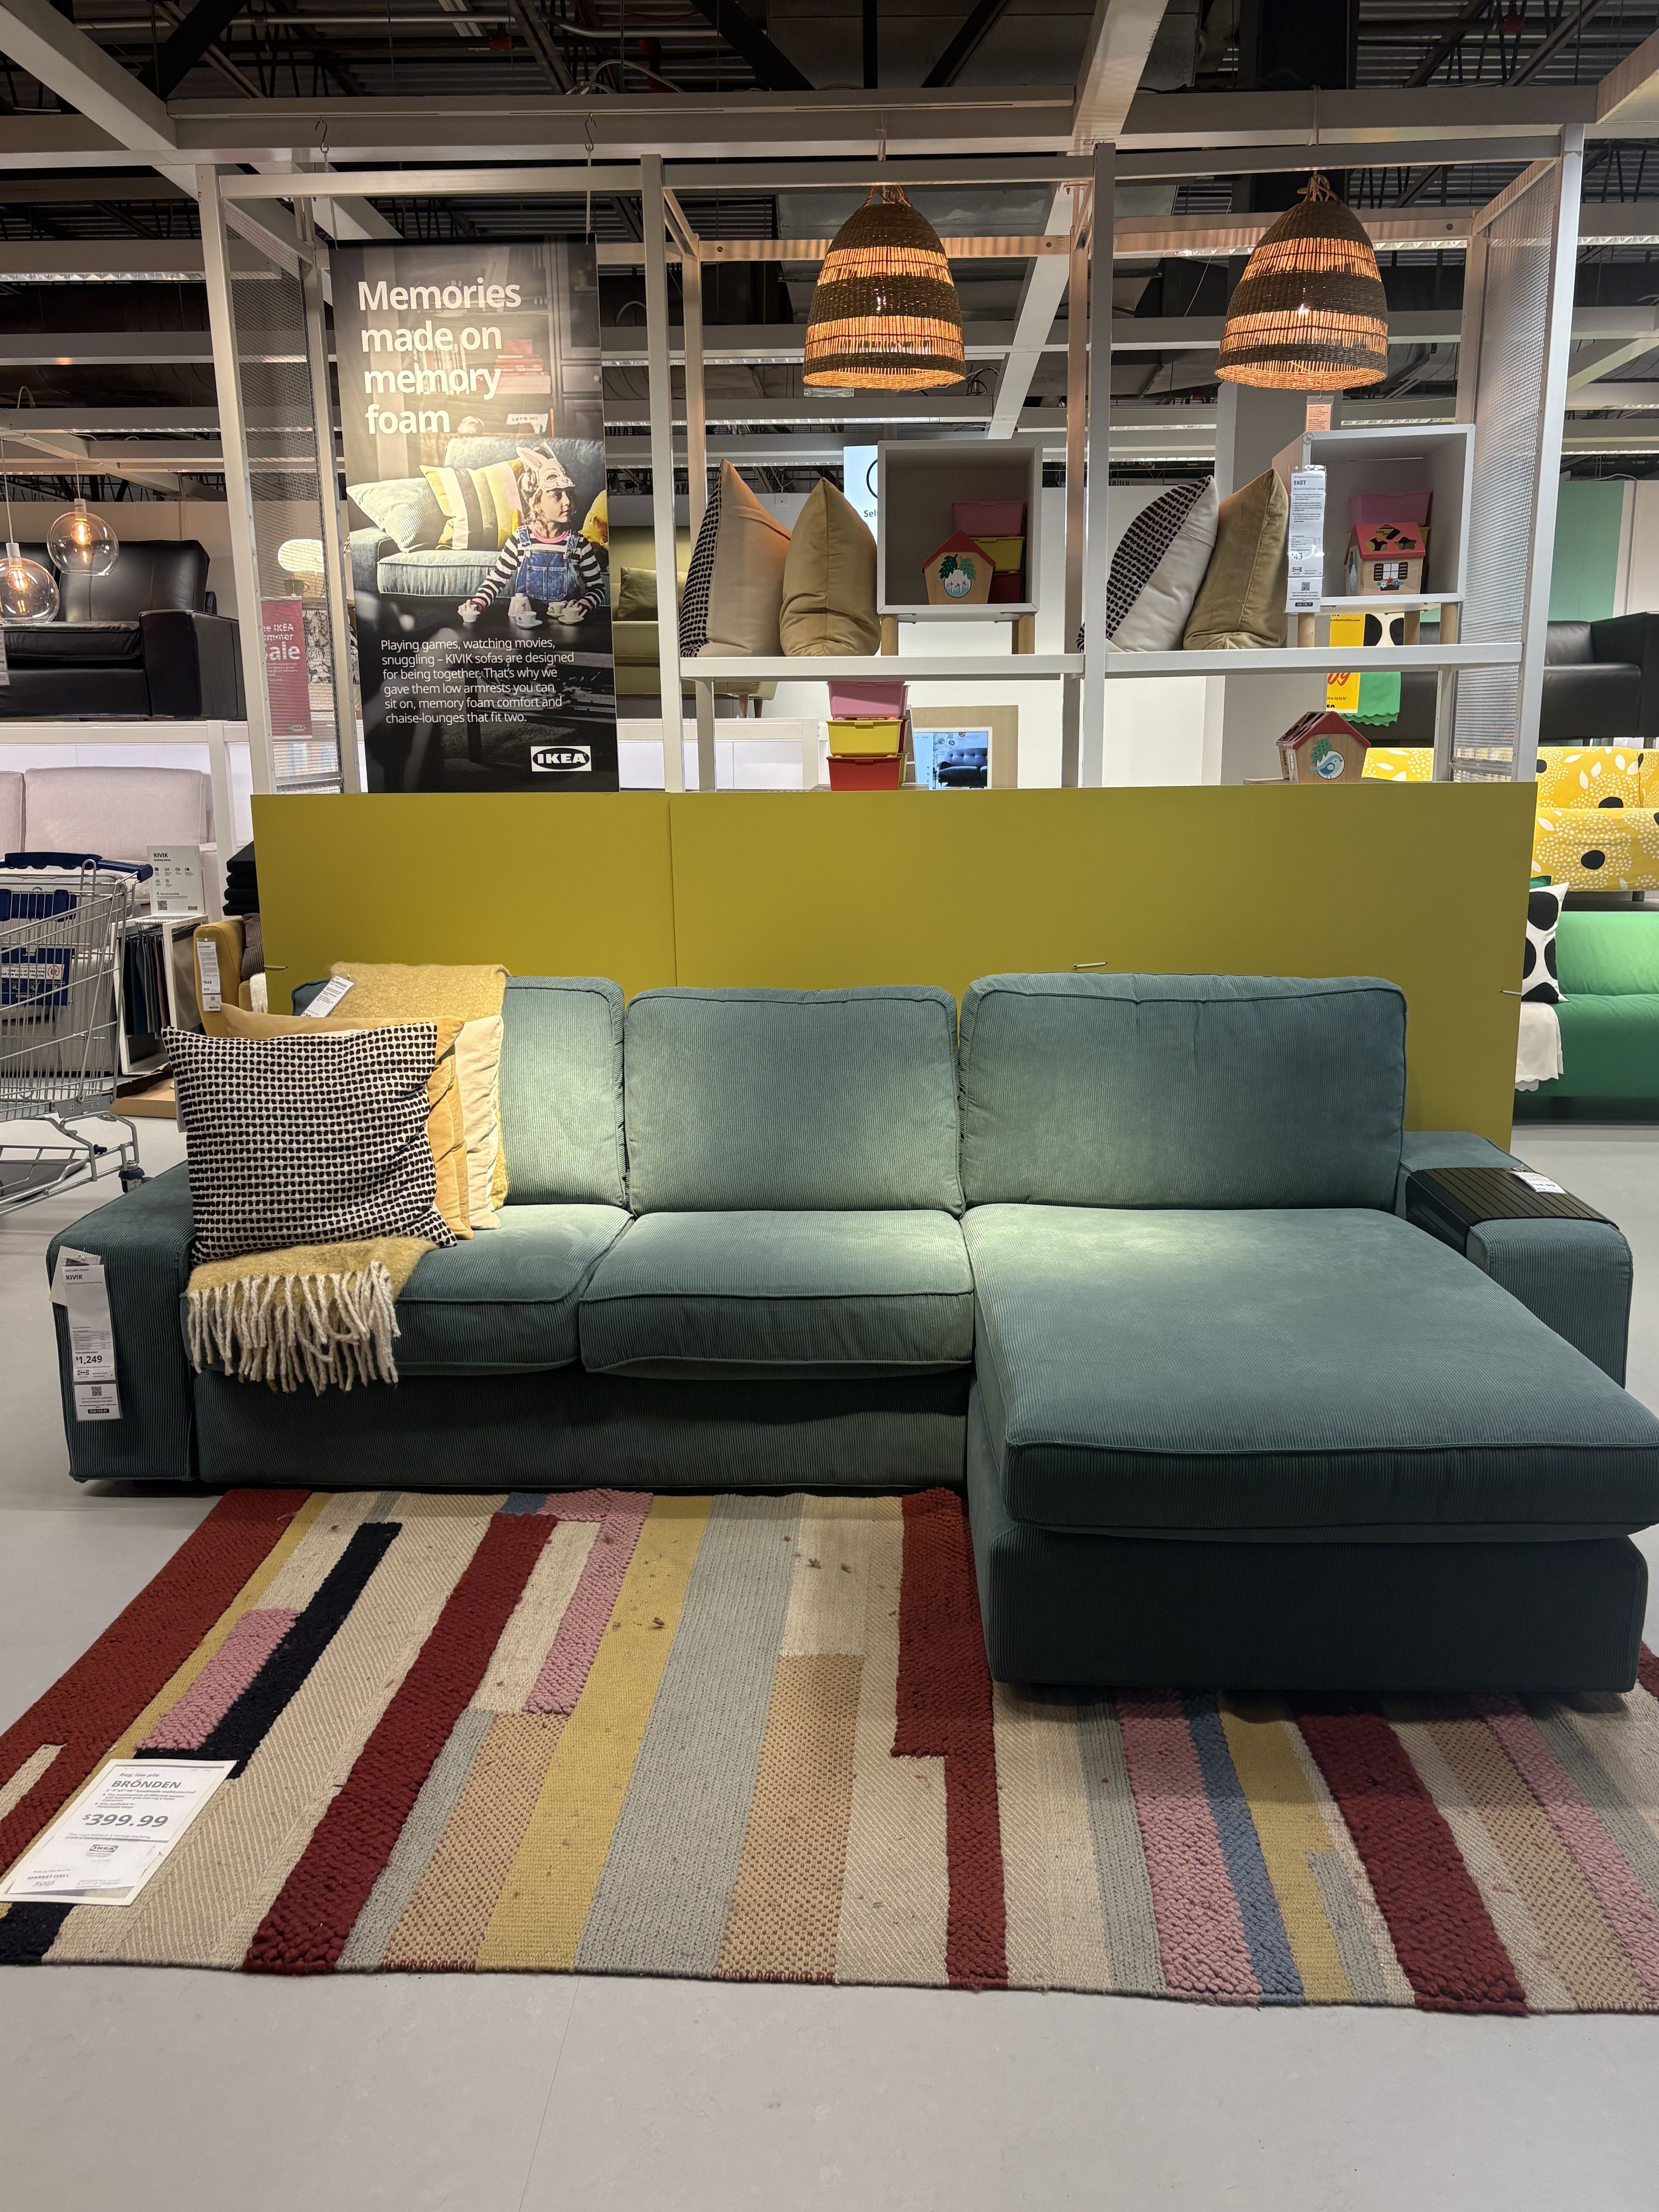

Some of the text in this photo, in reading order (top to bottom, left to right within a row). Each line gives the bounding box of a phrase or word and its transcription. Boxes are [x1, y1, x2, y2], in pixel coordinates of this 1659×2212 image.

[358, 277, 522, 311] Memories
[361, 320, 502, 352] made on
[364, 368, 502, 400] memory
[365, 404, 450, 434] foam
[274, 623, 294, 632] IKEA
[381, 638, 555, 653] Playing games, watching movies,
[382, 654, 434, 667] snuggling
[446, 654, 473, 664] KIVIK
[476, 653, 503, 663] sofas
[505, 655, 522, 663] are
[526, 653, 574, 665] designed
[383, 668, 557, 682] for being together. That's why we
[384, 684, 555, 697] gave them low armrests you can
[385, 696, 562, 711] sit on, memory foam comfort and
[386, 712, 527, 725] chaise-lounges that fit two.
[538, 754, 586, 764] IKEA
[76, 1355, 102, 1365] $1,249
[111, 1779, 182, 1788] BRÖNDEN
[82, 1814, 168, 1827] $399.99
